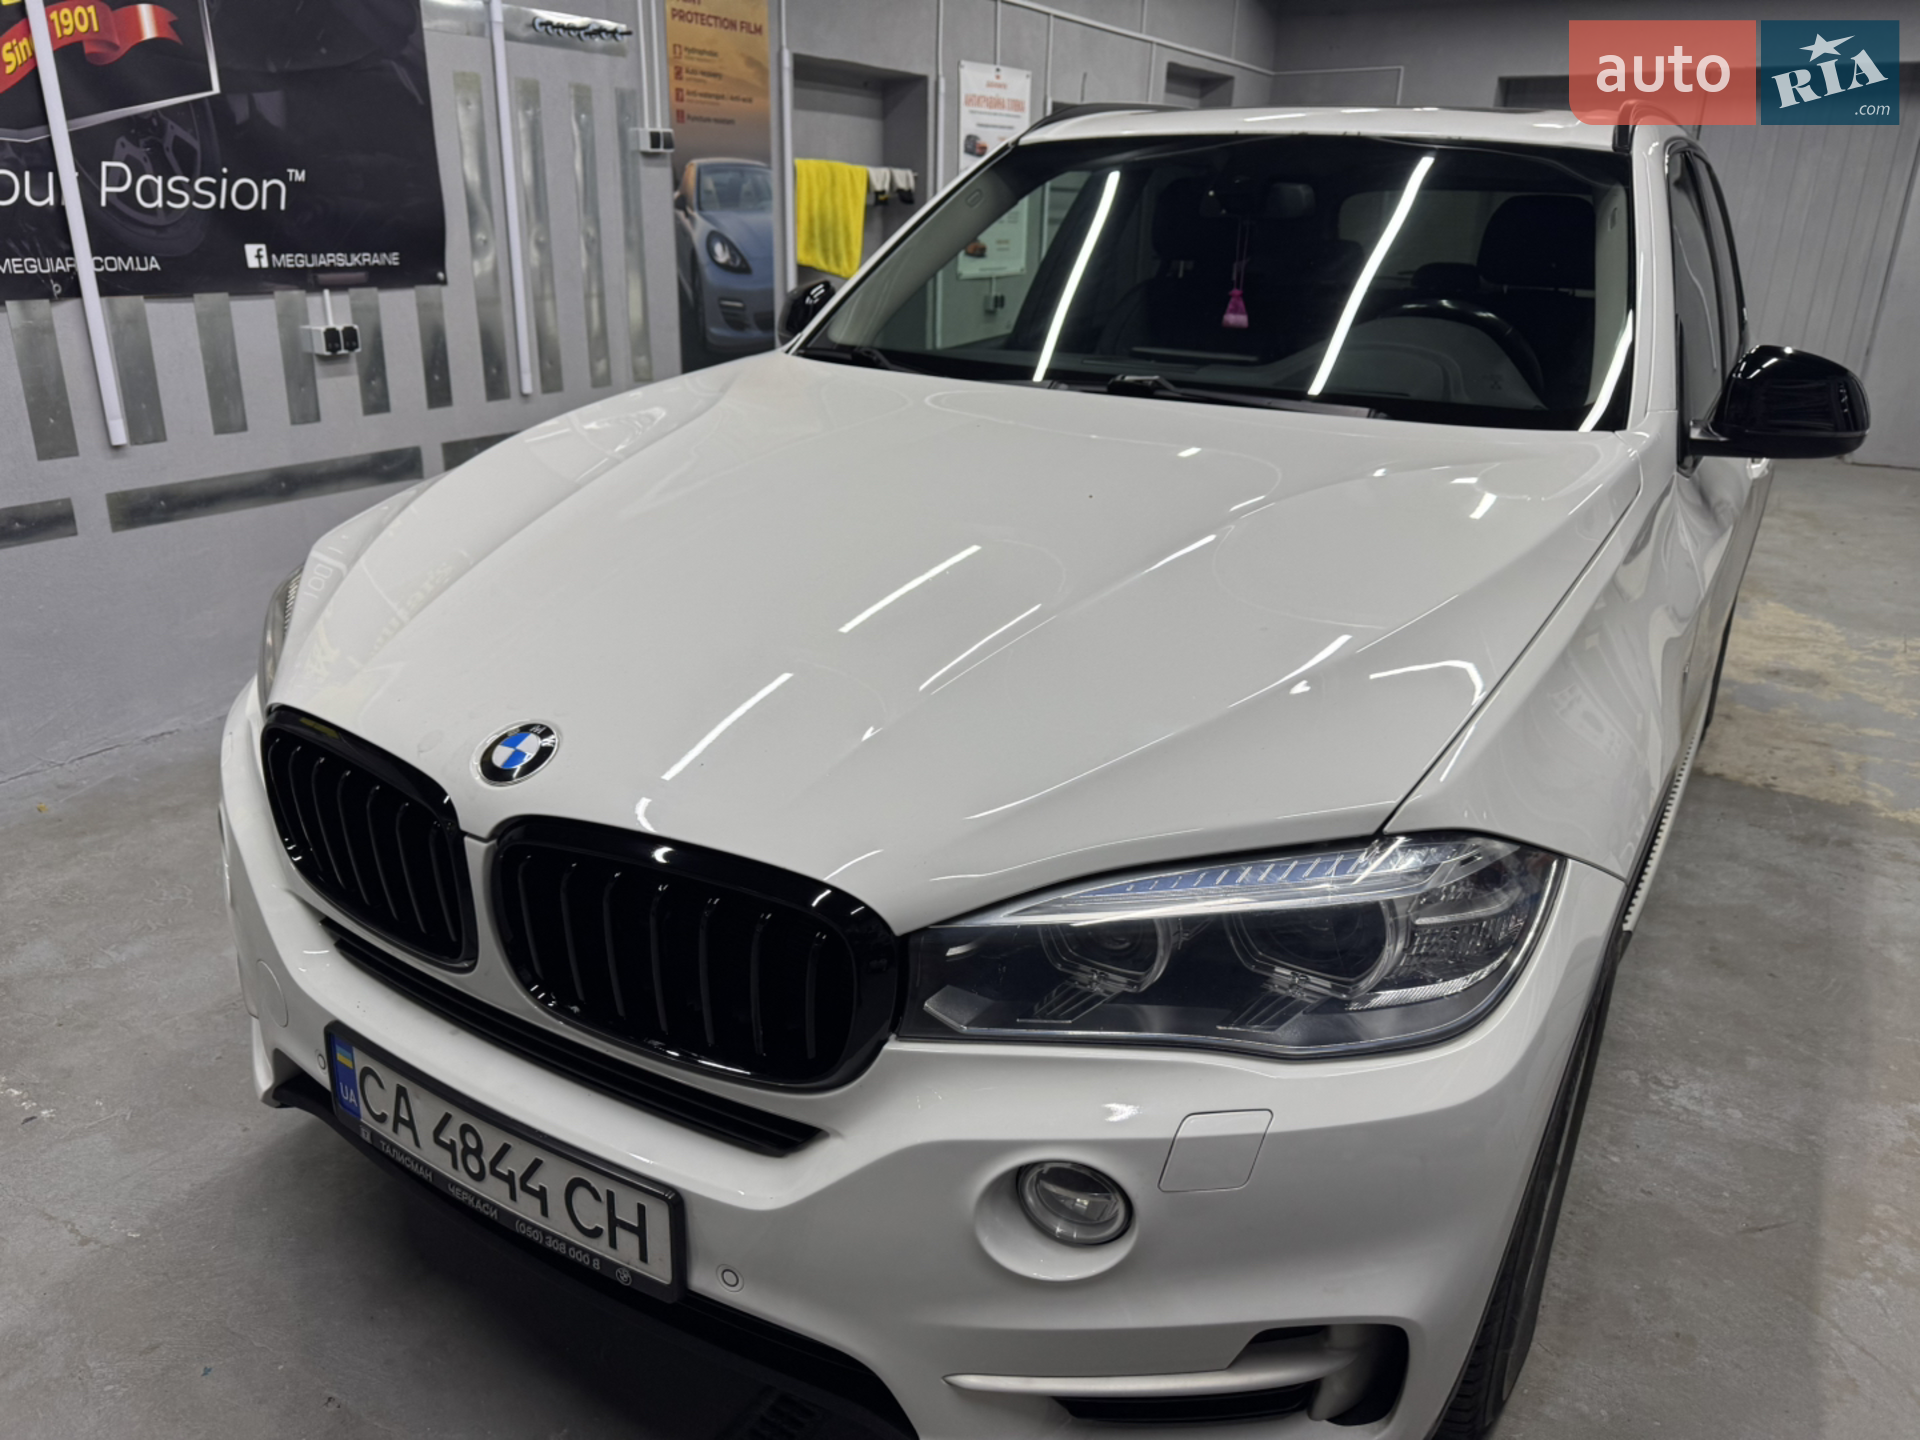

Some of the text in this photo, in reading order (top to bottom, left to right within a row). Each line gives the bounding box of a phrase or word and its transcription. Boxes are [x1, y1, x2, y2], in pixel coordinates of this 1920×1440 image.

[49, 4, 99, 38] 1901
[671, 8, 763, 35] PROTECTION FILM
[271, 251, 401, 268] MEGUIARSUKRAINE
[339, 1082, 358, 1108] UA
[358, 1065, 649, 1265] CA 4844 CH
[515, 1219, 544, 1244] (050)
[545, 1236, 567, 1254] 308
